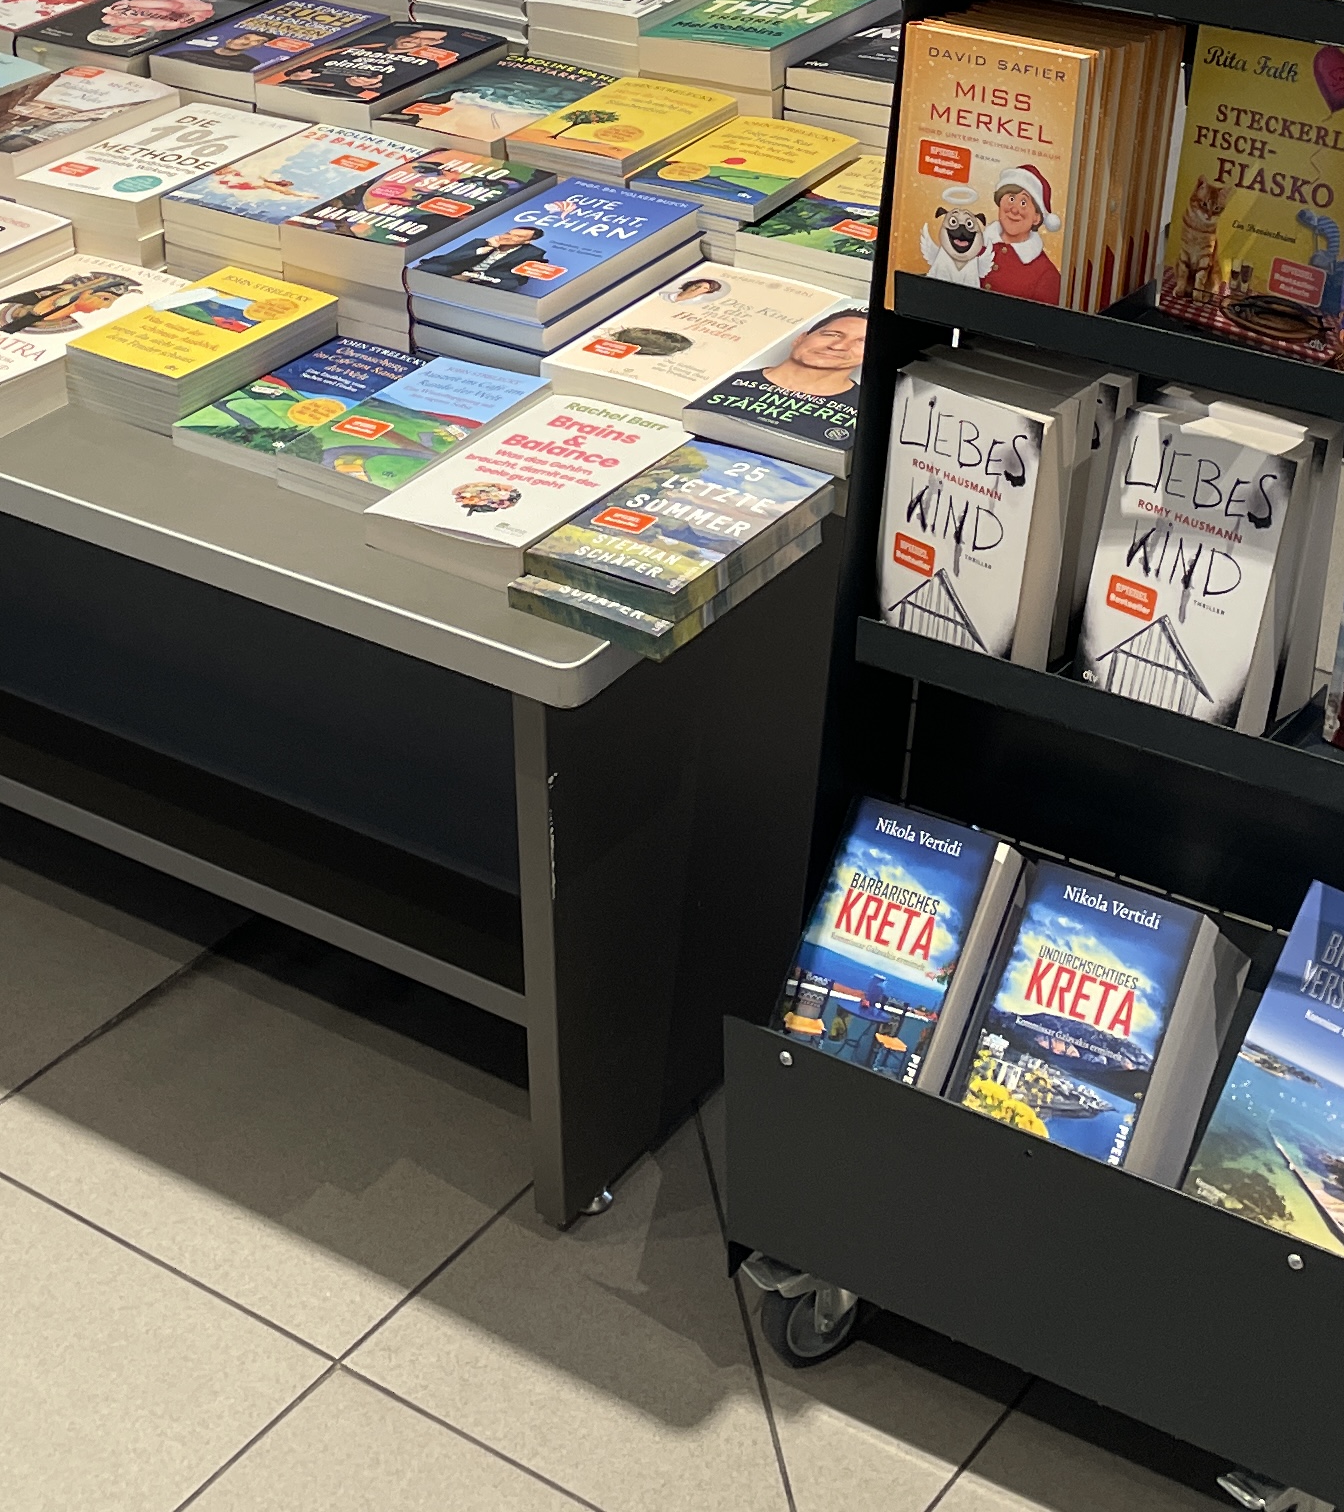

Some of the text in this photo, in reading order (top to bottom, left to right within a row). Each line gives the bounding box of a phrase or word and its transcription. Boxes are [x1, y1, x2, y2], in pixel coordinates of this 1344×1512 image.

[671, 21, 786, 38] Mel Robbins
[704, 0, 833, 24] THEM
[928, 45, 1066, 83] DAVID SAFIER
[1203, 45, 1300, 83] Rita Falk
[954, 81, 1033, 112] MISS
[175, 115, 221, 128] DIE
[930, 103, 1054, 145] MERKEL
[93, 140, 219, 171] METHODE
[137, 124, 241, 158] 1%
[303, 131, 412, 162] 22 BAHNEN
[1193, 125, 1278, 160] FISCH-
[440, 159, 510, 180] HALLO
[1213, 156, 1335, 209] FIASKO
[567, 191, 623, 215] GUTE
[314, 206, 429, 236] NAPOLITANO
[513, 209, 641, 242] GEHIRN
[564, 401, 669, 434] Rachel Barr
[707, 391, 798, 424] STÄRKE
[546, 414, 641, 447] Brains
[564, 434, 590, 450] &
[501, 433, 620, 471] Balance
[723, 461, 766, 483] 25
[912, 458, 1002, 502] ROMY HAUSMANN
[1137, 498, 1243, 544] ROMY HAUSMANN
[574, 544, 664, 580] SCHÄFER
[592, 532, 682, 567] STEPHAN
[875, 817, 963, 858] Nikola Vertidi
[850, 872, 941, 916] BARBARISCHES
[1063, 884, 1161, 931] Nikola Vertidi
[834, 888, 937, 961] KRETA
[1039, 944, 1139, 991] UNDURCHSICHTIGES
[1024, 957, 1136, 1038] KRETA
[1107, 1123, 1129, 1166] PIPER
